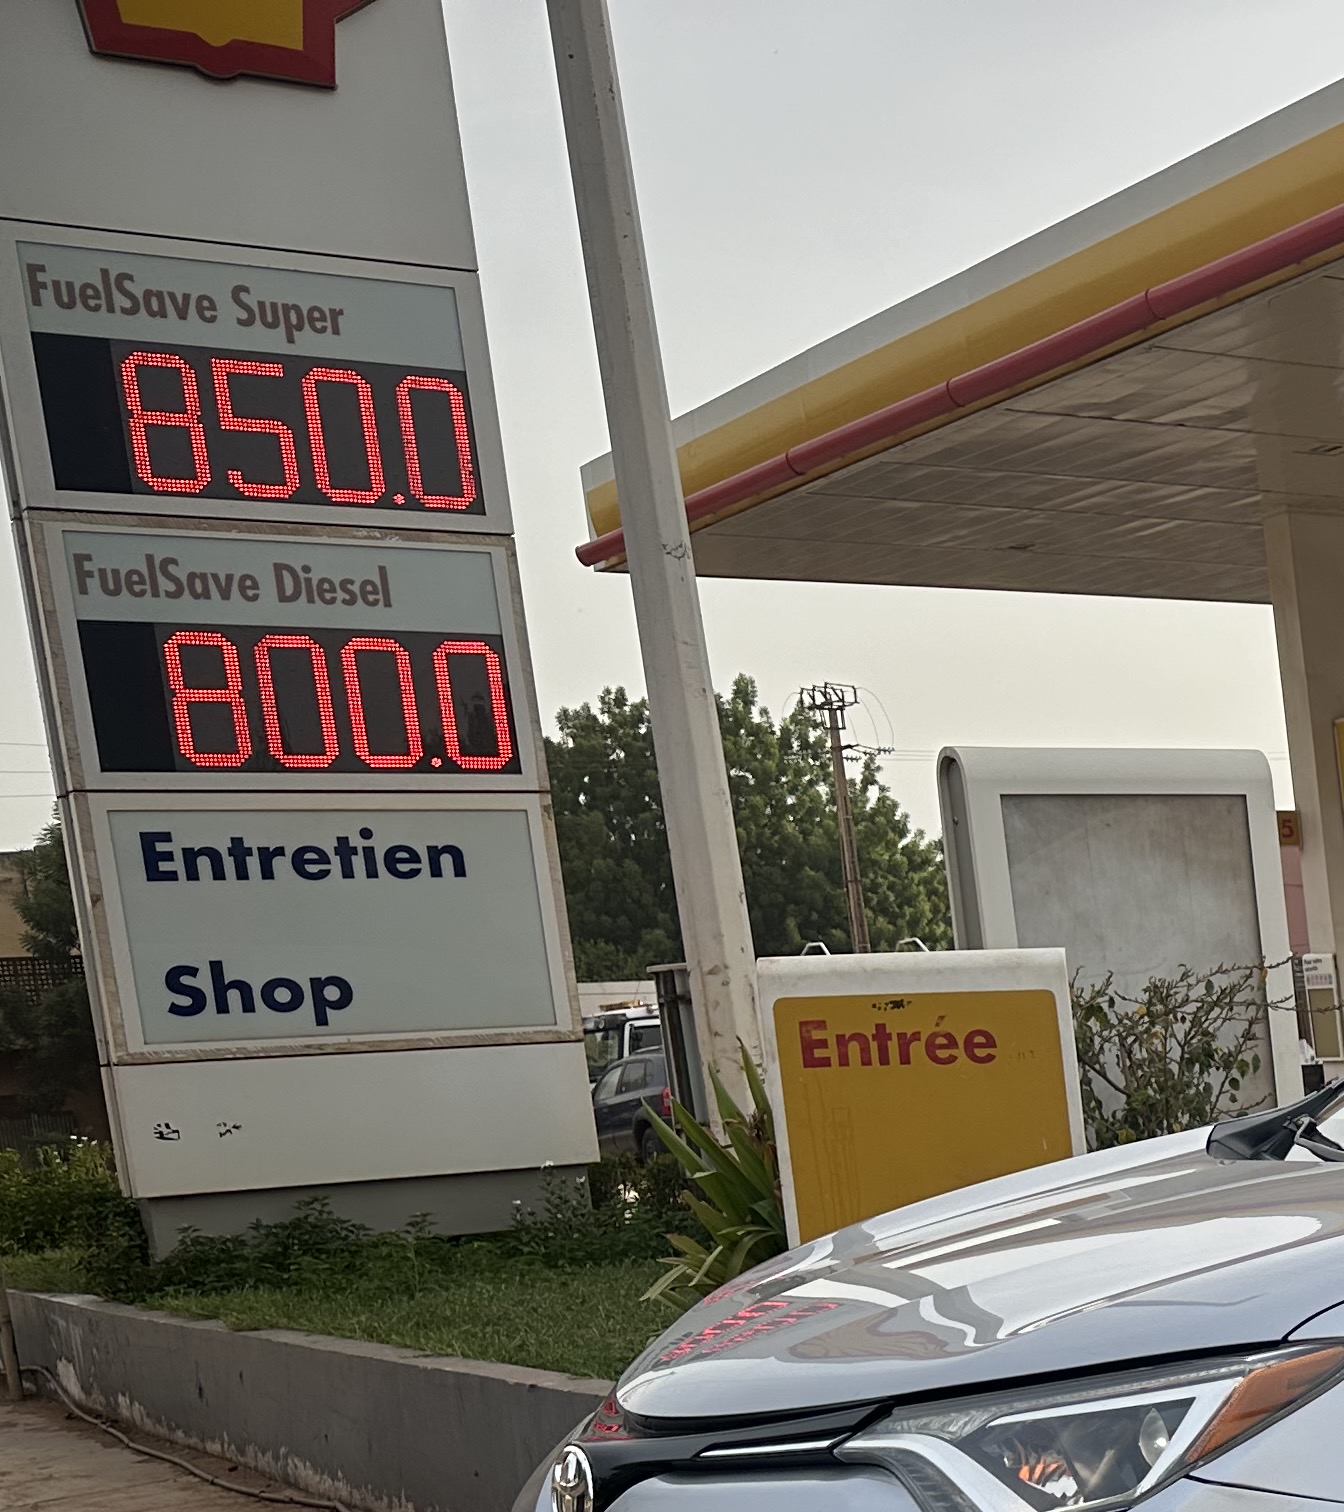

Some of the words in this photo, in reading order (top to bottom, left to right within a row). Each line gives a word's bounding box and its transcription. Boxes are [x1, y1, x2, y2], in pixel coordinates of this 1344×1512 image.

[25, 263, 218, 324] FuelSave
[230, 284, 345, 344] Super
[119, 350, 477, 510] 850.0
[72, 552, 260, 601] FuelSave
[273, 562, 393, 609] Diesel
[162, 630, 513, 770] 800.0
[139, 827, 467, 882] Entretien
[1282, 818, 1294, 839] 5
[164, 960, 354, 1027] Shop
[798, 1015, 998, 1069] Entrée
